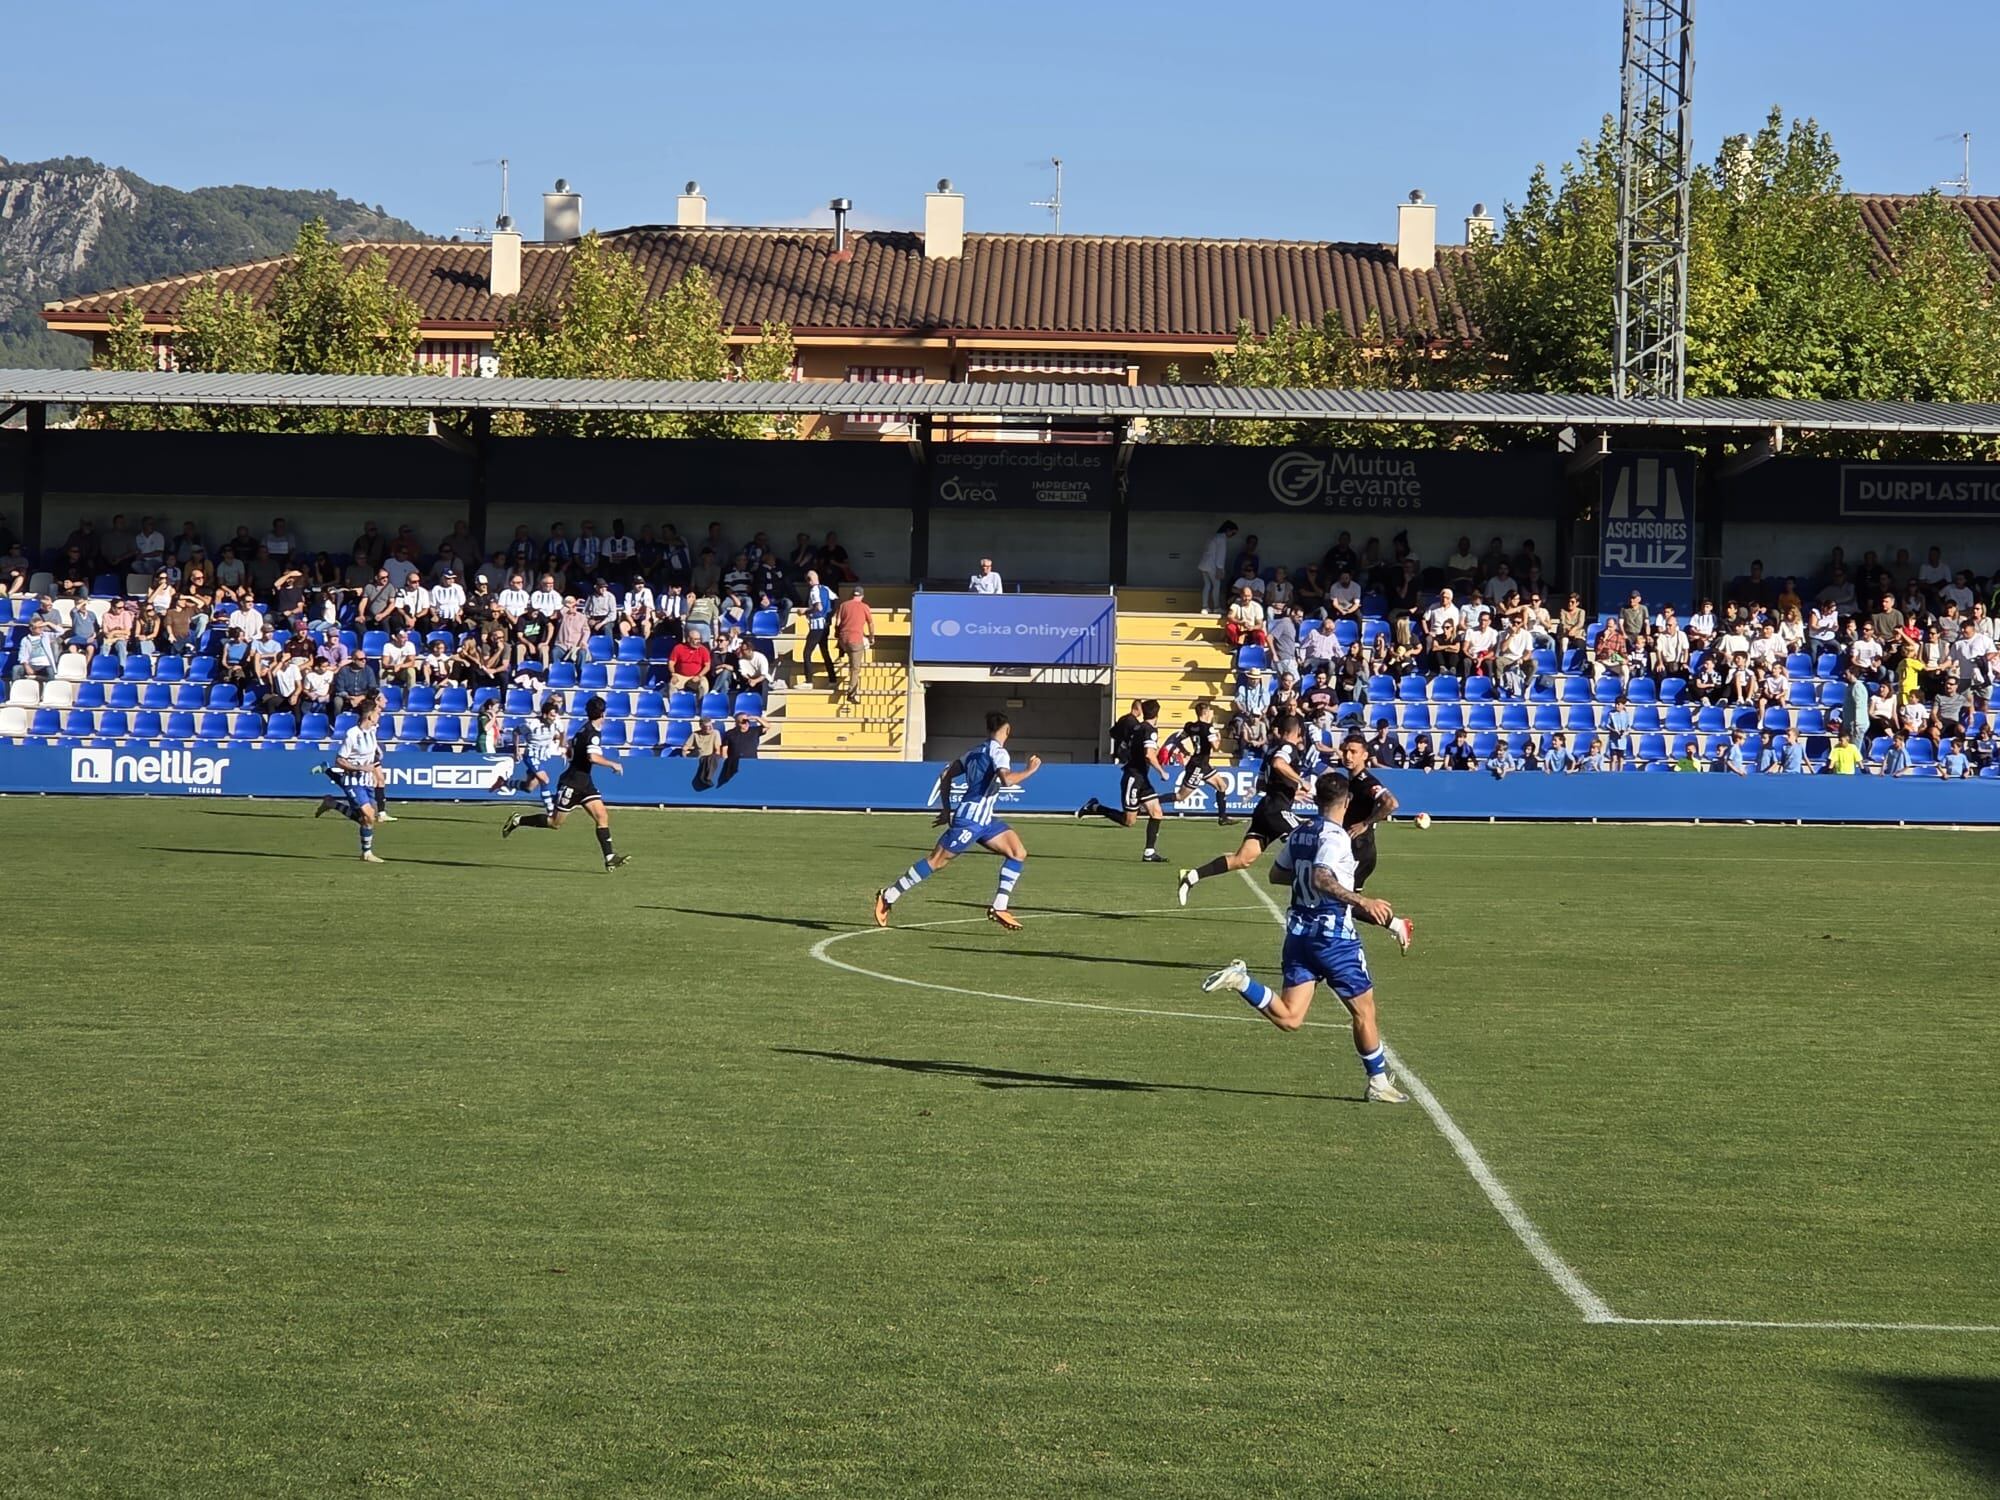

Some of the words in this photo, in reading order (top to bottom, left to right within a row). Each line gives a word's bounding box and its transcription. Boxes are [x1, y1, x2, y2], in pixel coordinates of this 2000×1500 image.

[936, 449, 1102, 471] areagraficadigital.es
[1329, 453, 1417, 477] Mutua
[1032, 480, 1091, 491] IMPRENTA
[1325, 475, 1421, 496] Levante
[1325, 496, 1422, 508] SEGUROS
[1606, 521, 1687, 540] ASCENSORES
[965, 622, 1011, 636] Caixa
[1015, 623, 1097, 640] Ontinyent
[115, 750, 230, 785] netllar
[958, 829, 972, 844] 19
